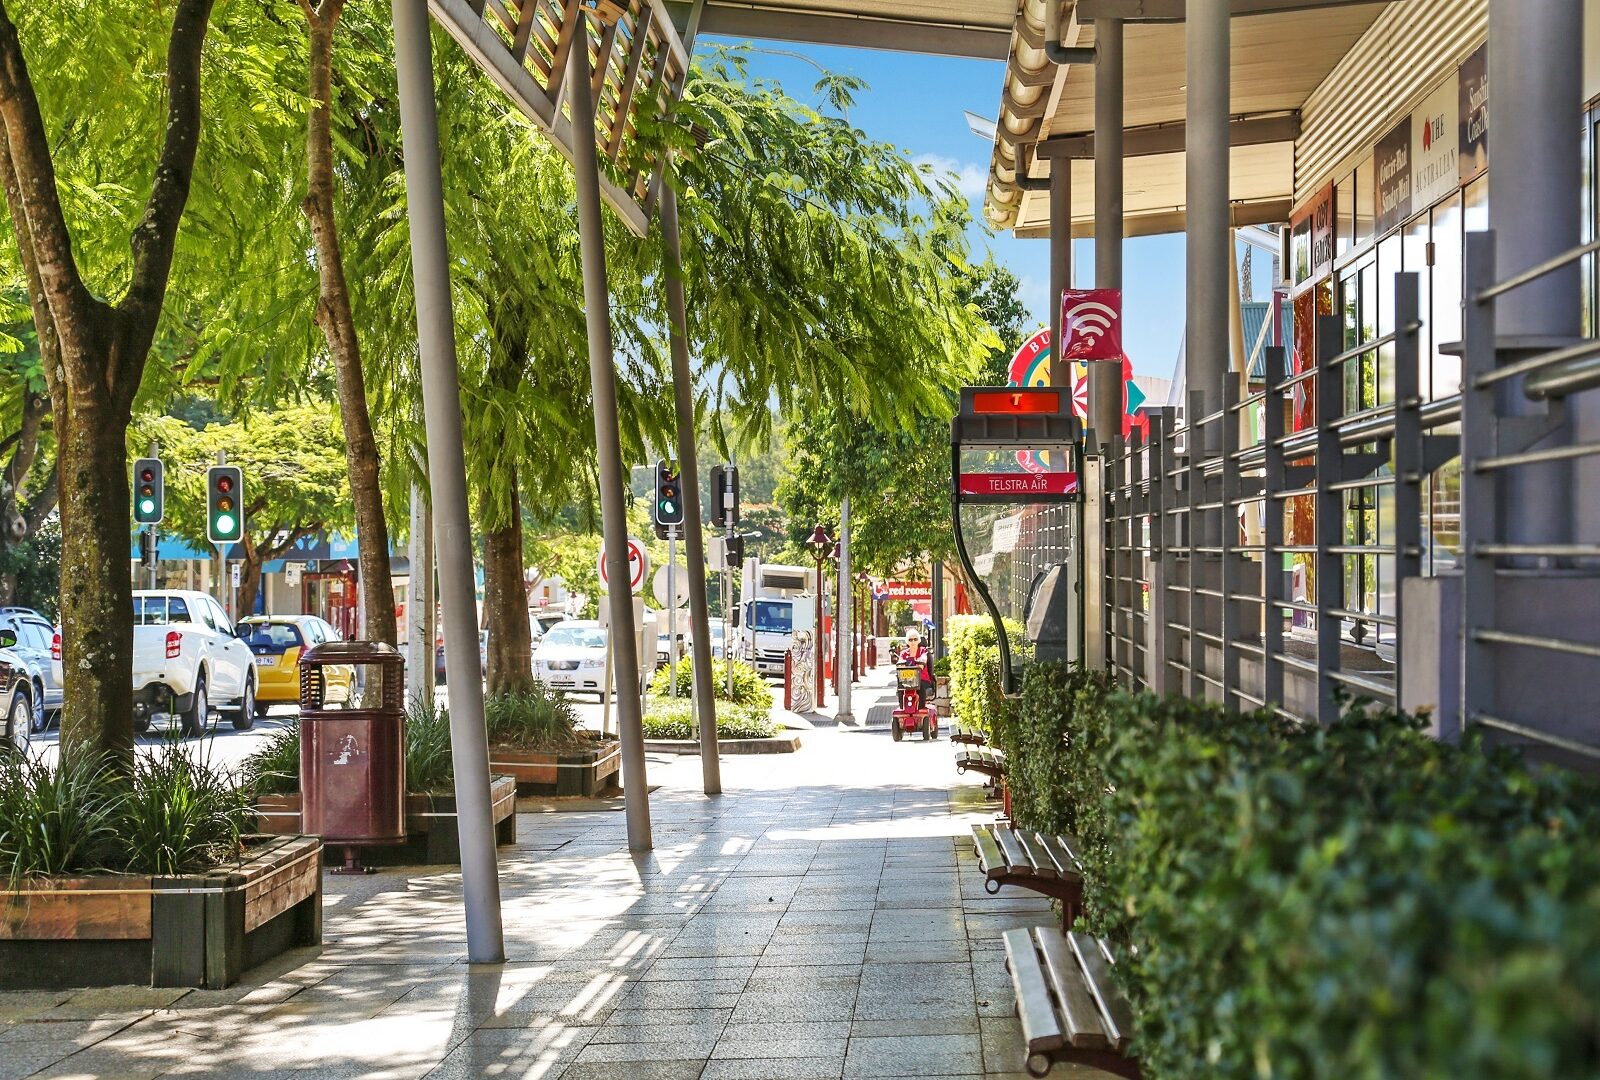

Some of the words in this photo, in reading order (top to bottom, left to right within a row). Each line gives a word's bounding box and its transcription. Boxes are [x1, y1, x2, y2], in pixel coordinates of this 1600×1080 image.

[1431, 113, 1445, 144] THE
[1415, 147, 1456, 195] AUSTRALIAN
[1029, 332, 1051, 354] BU
[1012, 393, 1023, 406] T
[988, 479, 1029, 491] TELSTRA
[888, 585, 905, 596] red
[905, 587, 932, 595] rooste
